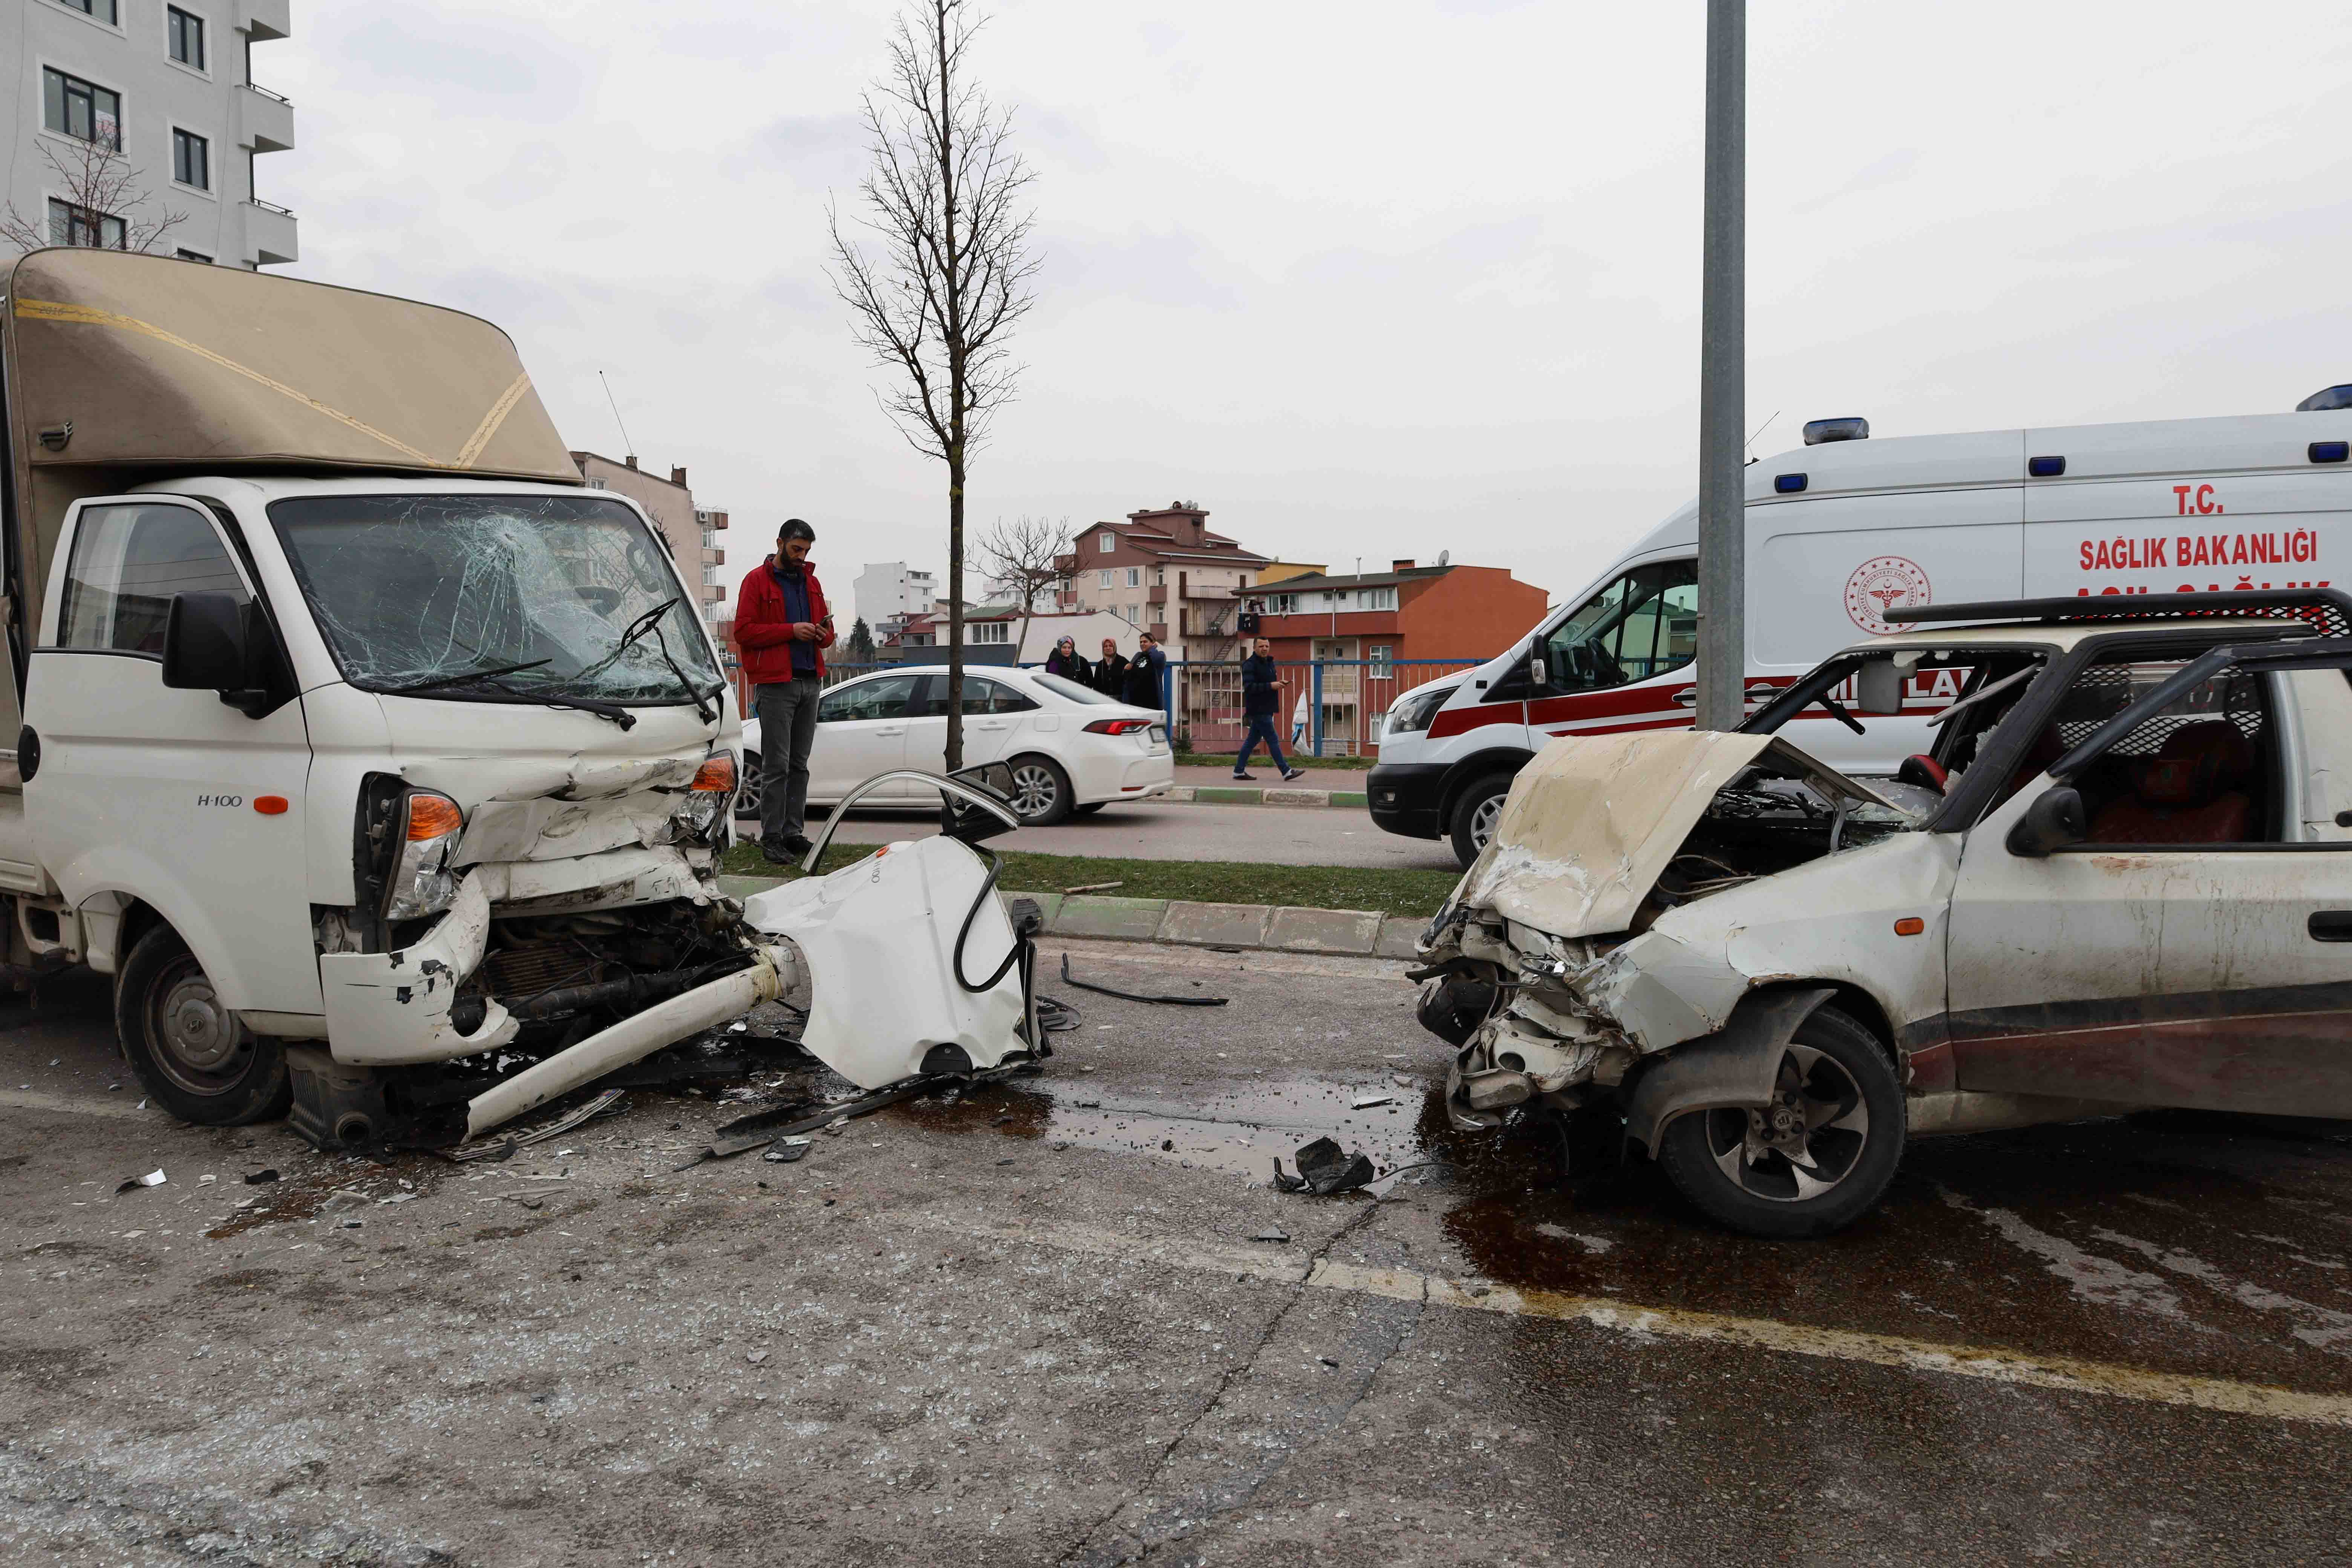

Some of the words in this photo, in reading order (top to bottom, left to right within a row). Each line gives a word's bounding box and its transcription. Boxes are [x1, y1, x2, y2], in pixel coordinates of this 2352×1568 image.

[2173, 484, 2223, 515] T.C.
[2080, 536, 2167, 570] SAĞLIK
[2177, 528, 2317, 567] BAKANLIĞI
[198, 795, 242, 807] H-100
